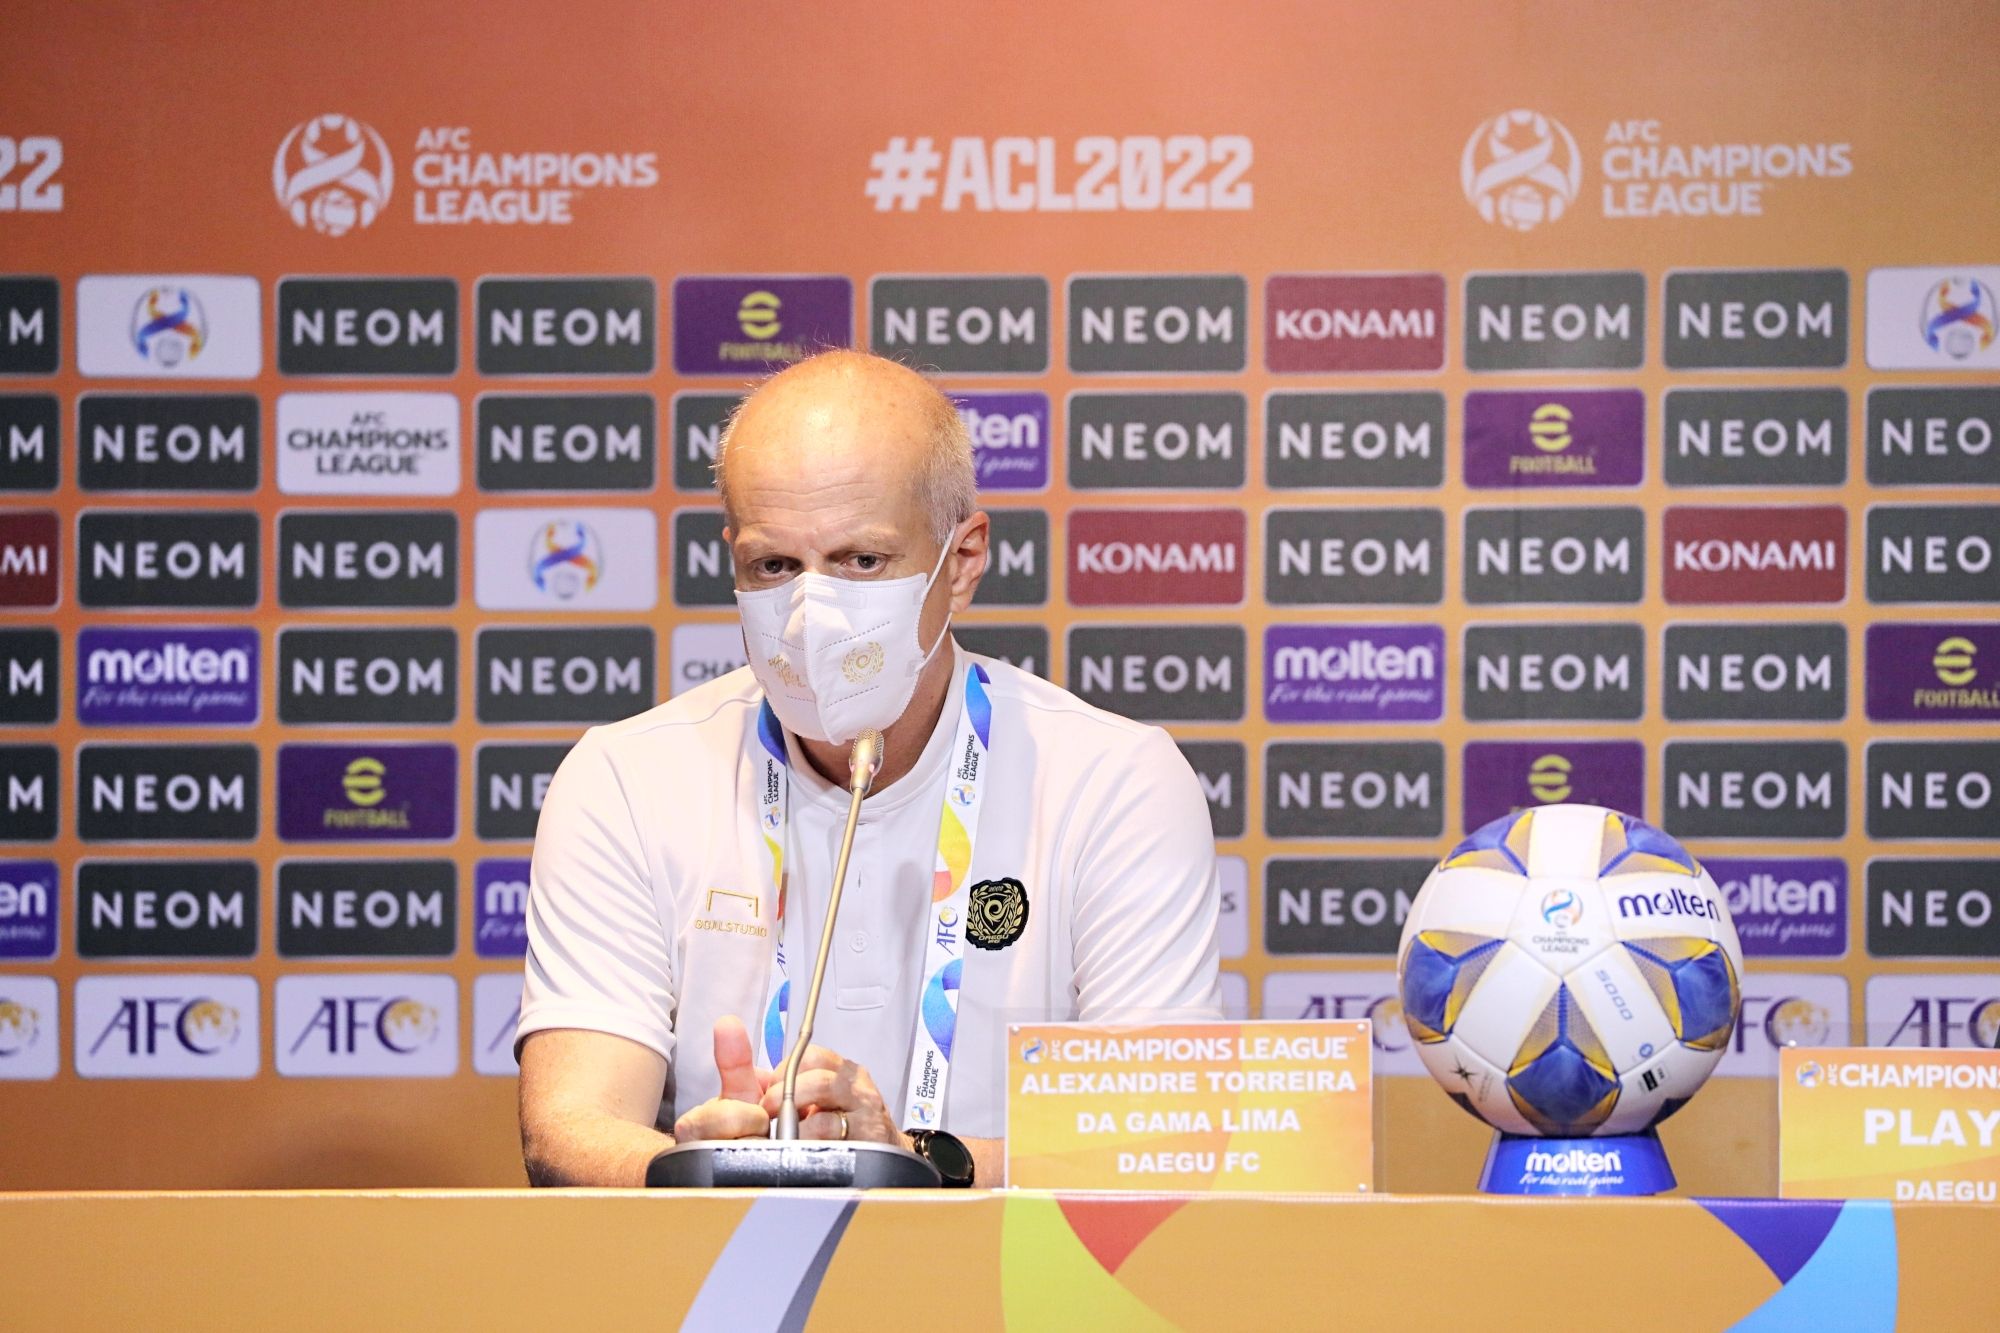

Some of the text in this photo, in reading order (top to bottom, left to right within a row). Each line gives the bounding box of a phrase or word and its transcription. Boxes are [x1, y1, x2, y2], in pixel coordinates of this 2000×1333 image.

[415, 126, 470, 150] AFC
[1605, 119, 1659, 143] AFC
[412, 152, 660, 187] CHAMPIONS
[865, 136, 1253, 212] #ACL2022
[1601, 143, 1854, 179] CHAMPIONS
[413, 190, 573, 224] LEAGUE
[1603, 183, 1763, 217] LEAGUE
[293, 308, 444, 346] NEOM
[491, 308, 641, 346] NEOM
[885, 307, 1035, 344] NEOM
[1082, 306, 1233, 343] NEOM
[1276, 309, 1435, 339] KONAMI
[1479, 304, 1630, 341] NEOM
[1679, 302, 1832, 339] NEOM
[352, 411, 386, 425] AFC
[93, 425, 245, 462] NEOM
[287, 428, 449, 451] CHAMPIONS
[491, 424, 641, 462] NEOM
[1082, 422, 1232, 460] NEOM
[1279, 422, 1430, 459] NEOM
[1678, 419, 1831, 456] NEOM
[315, 453, 419, 477] LEAGUE
[1509, 454, 1596, 475] FOOTBALL
[93, 541, 244, 579] NEOM
[293, 541, 443, 579] NEOM
[1078, 542, 1235, 573] KONAMI
[1279, 539, 1430, 576] NEOM
[1478, 537, 1629, 574] NEOM
[1674, 540, 1835, 571] KONAMI
[87, 641, 250, 685] molten
[293, 658, 443, 695] NEOM
[490, 656, 641, 695] NEOM
[1081, 655, 1232, 692] NEOM
[1273, 639, 1435, 682] molten
[1478, 654, 1629, 691] NEOM
[1678, 654, 1831, 691] NEOM
[1913, 687, 2000, 709] FOOTBALL
[962, 733, 975, 780] CHAMPIONS
[969, 752, 979, 781] LEAGUE
[93, 775, 244, 812] NEOM
[1279, 771, 1430, 809] NEOM
[1678, 771, 1831, 809] NEOM
[323, 807, 410, 829] FOOTBALL
[92, 891, 243, 928] NEOM
[292, 890, 442, 928] NEOM
[1617, 888, 1722, 922] molten
[1720, 873, 1838, 917] olten
[694, 919, 768, 938] GOALSTUDIO
[1532, 935, 1590, 946] CHAMPIONS
[1541, 945, 1580, 954] LEAGUE
[1595, 969, 1635, 1021] 5000
[89, 997, 241, 1056] AFC
[289, 997, 439, 1055] AFC
[1062, 1036, 1348, 1062] CHAMPIONS LEAGUE
[921, 1050, 934, 1098] CHAMPIONS
[928, 1068, 939, 1099] LEAGUE
[1020, 1069, 1357, 1095] ALEXANDRE TORREIRA
[1839, 1063, 2000, 1089] CHAMPION
[1076, 1108, 1301, 1134] DA GAMA LIMA
[1117, 1151, 1261, 1175] DAEGU FC
[1525, 1149, 1622, 1173] molten
[1895, 1180, 1998, 1200] DAEGU
